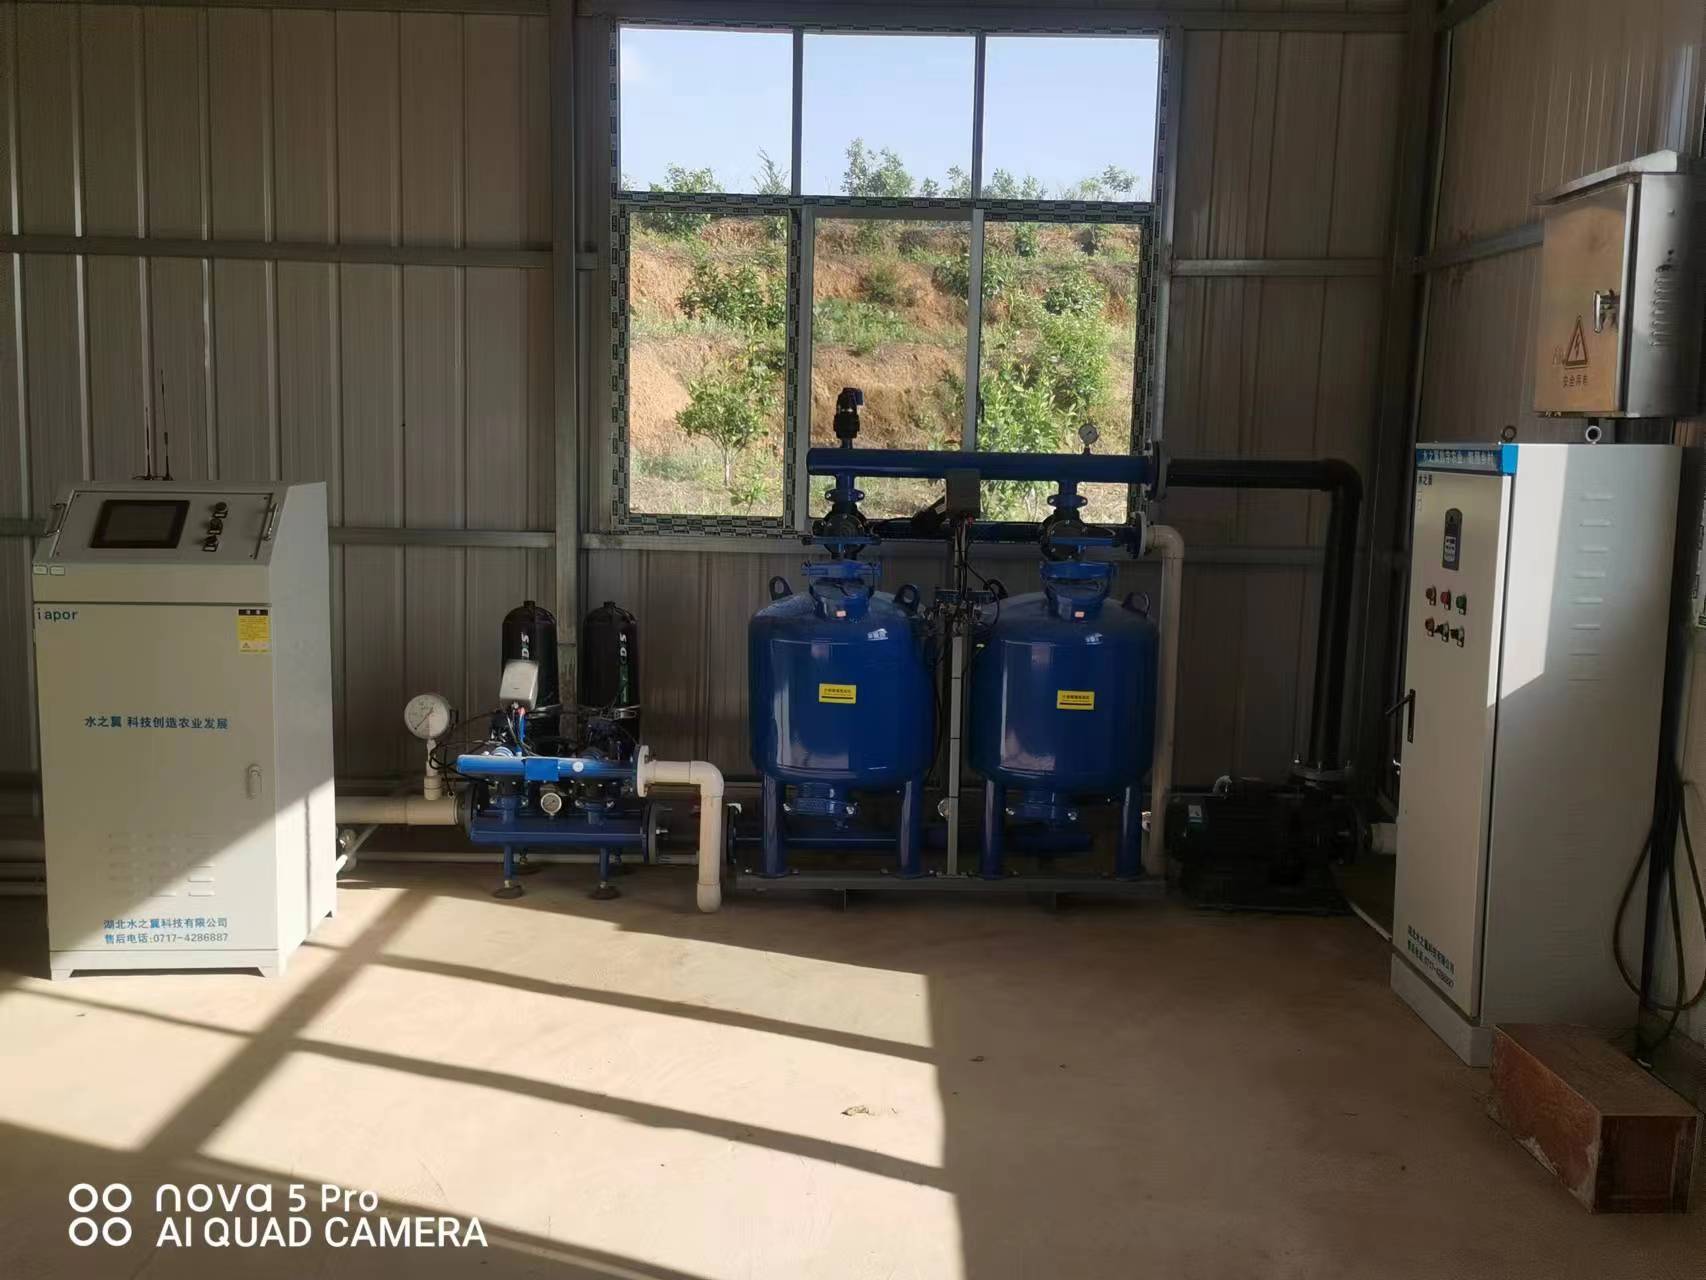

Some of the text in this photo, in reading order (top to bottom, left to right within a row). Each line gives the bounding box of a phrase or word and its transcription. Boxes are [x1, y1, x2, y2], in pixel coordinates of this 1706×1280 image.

[85, 716, 228, 729] 水之翼 科技创造农业发展
[104, 918, 228, 930] 湖北水之翼科技有限公司
